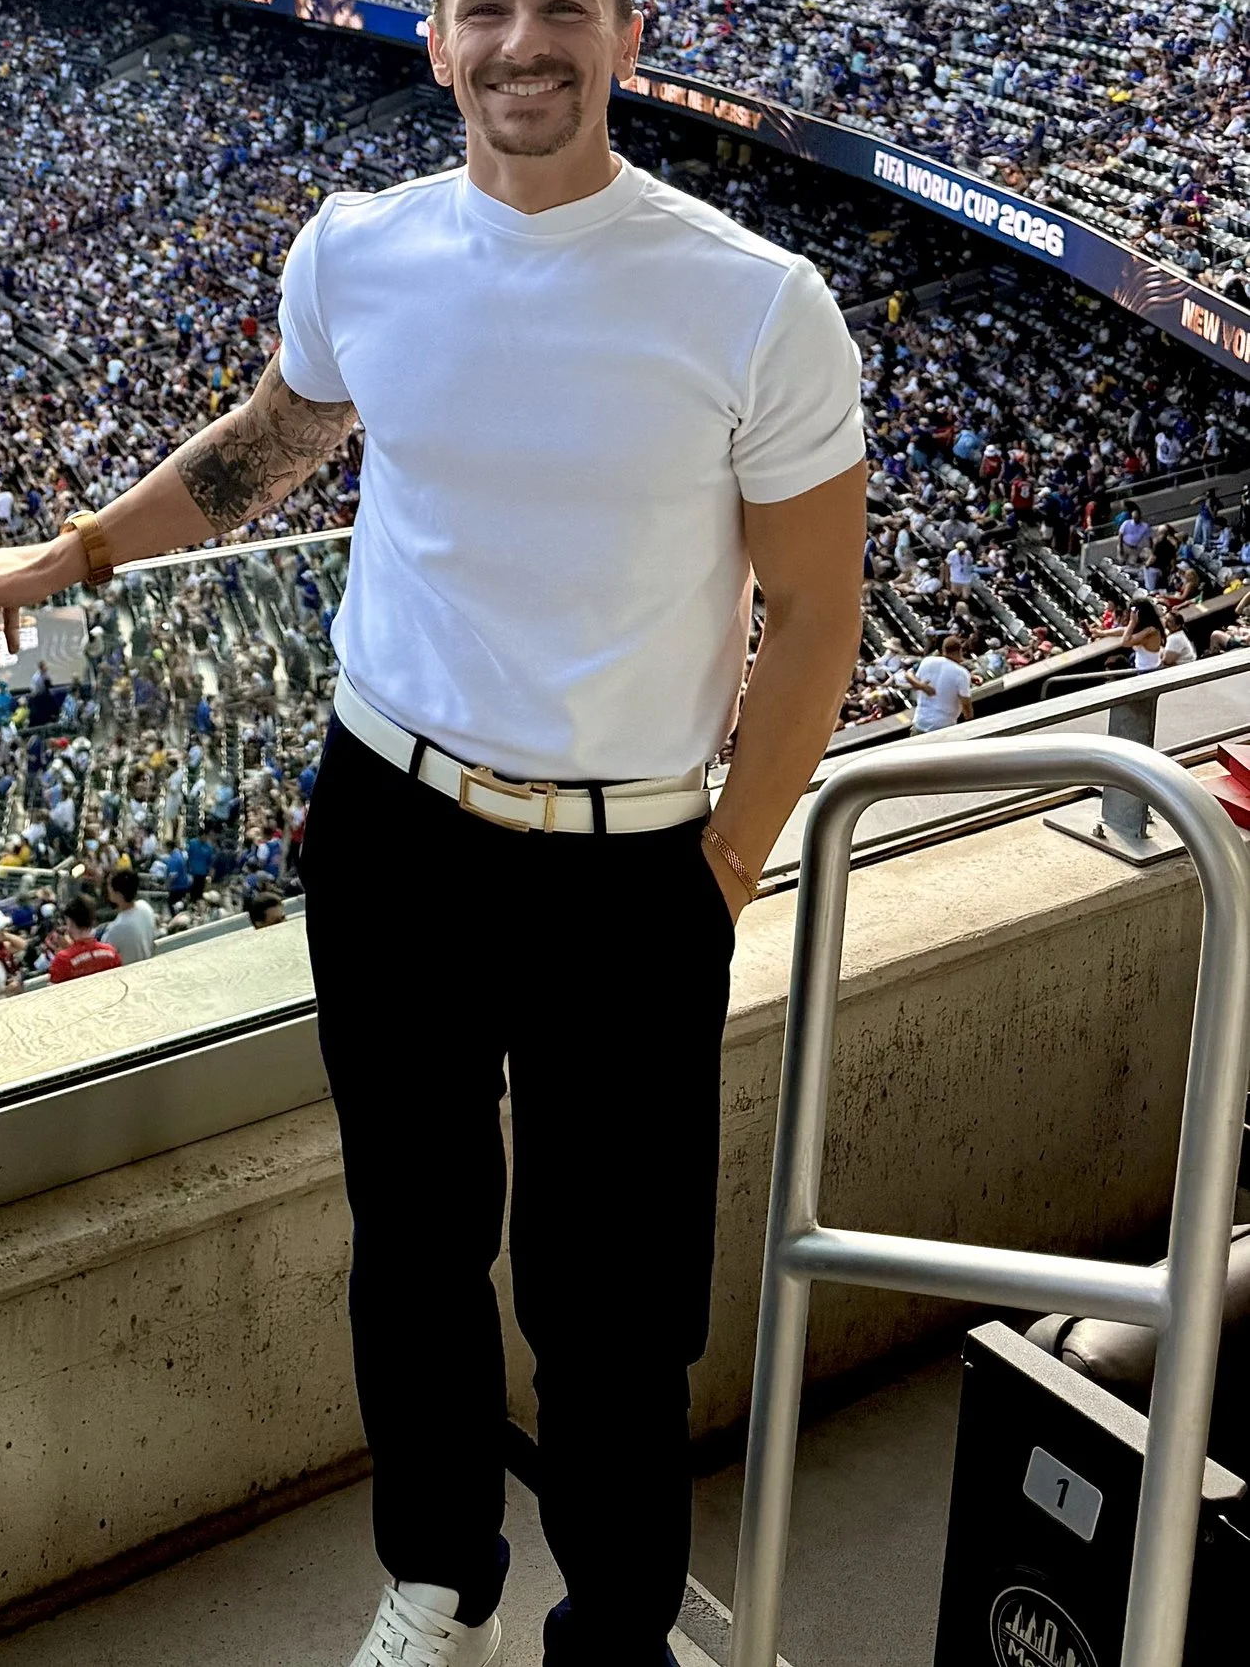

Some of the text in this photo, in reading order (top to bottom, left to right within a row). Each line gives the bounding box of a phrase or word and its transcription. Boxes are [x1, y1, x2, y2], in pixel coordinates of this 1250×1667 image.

[715, 98, 763, 132] JERSEY
[873, 149, 1065, 258] FIFA WORLD CUP 2026
[1181, 297, 1221, 345] NEW
[1056, 1478, 1070, 1510] 1
